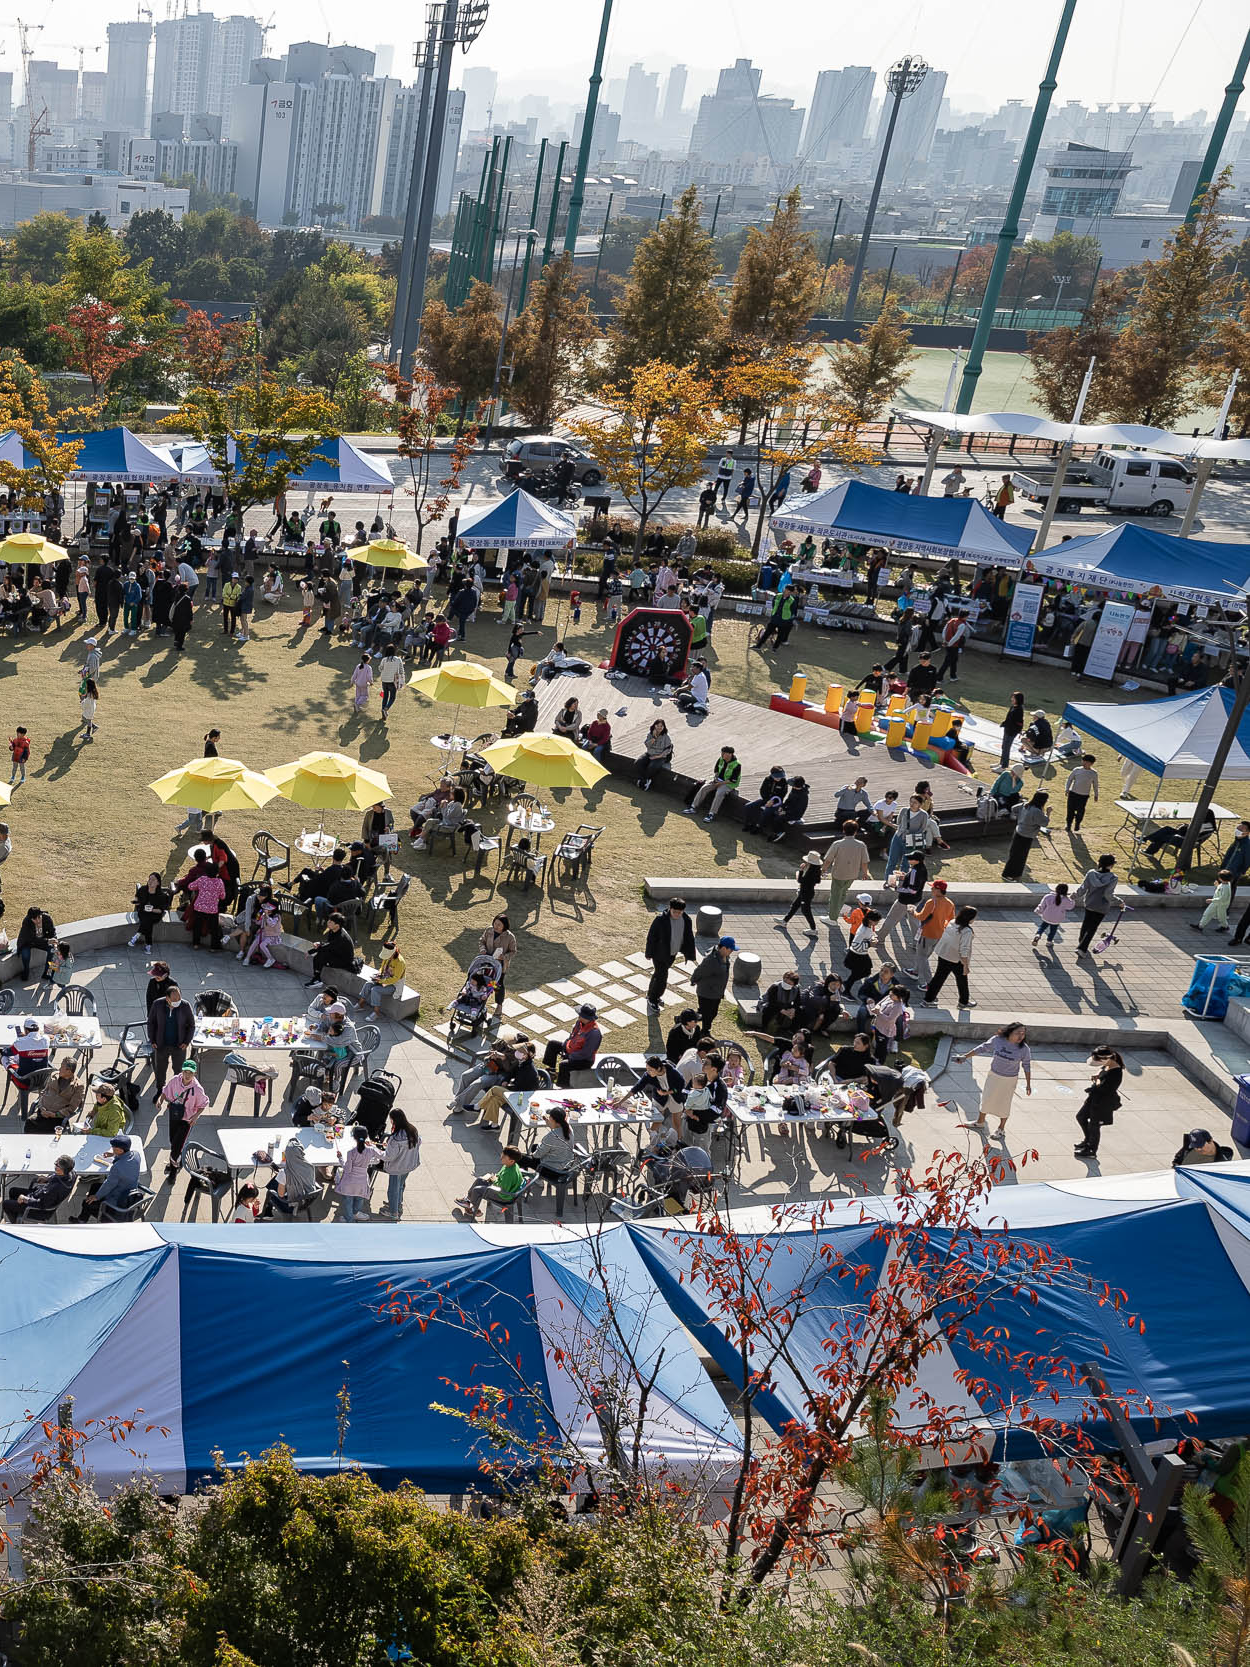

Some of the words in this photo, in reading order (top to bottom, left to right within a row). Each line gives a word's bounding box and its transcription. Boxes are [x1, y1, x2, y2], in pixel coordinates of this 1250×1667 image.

[278, 99, 293, 109] 금호
[275, 111, 286, 119] 103
[92, 473, 113, 482] 광장동
[309, 481, 329, 490] 광장동
[778, 519, 797, 530] 광장동
[797, 523, 816, 535] 새마을
[816, 526, 848, 538] 작은도서관
[467, 539, 491, 547] 광장동
[493, 538, 545, 548] 문화행사위원회
[896, 540, 913, 550] 광장동
[1045, 565, 1108, 585] 광진복지재단
